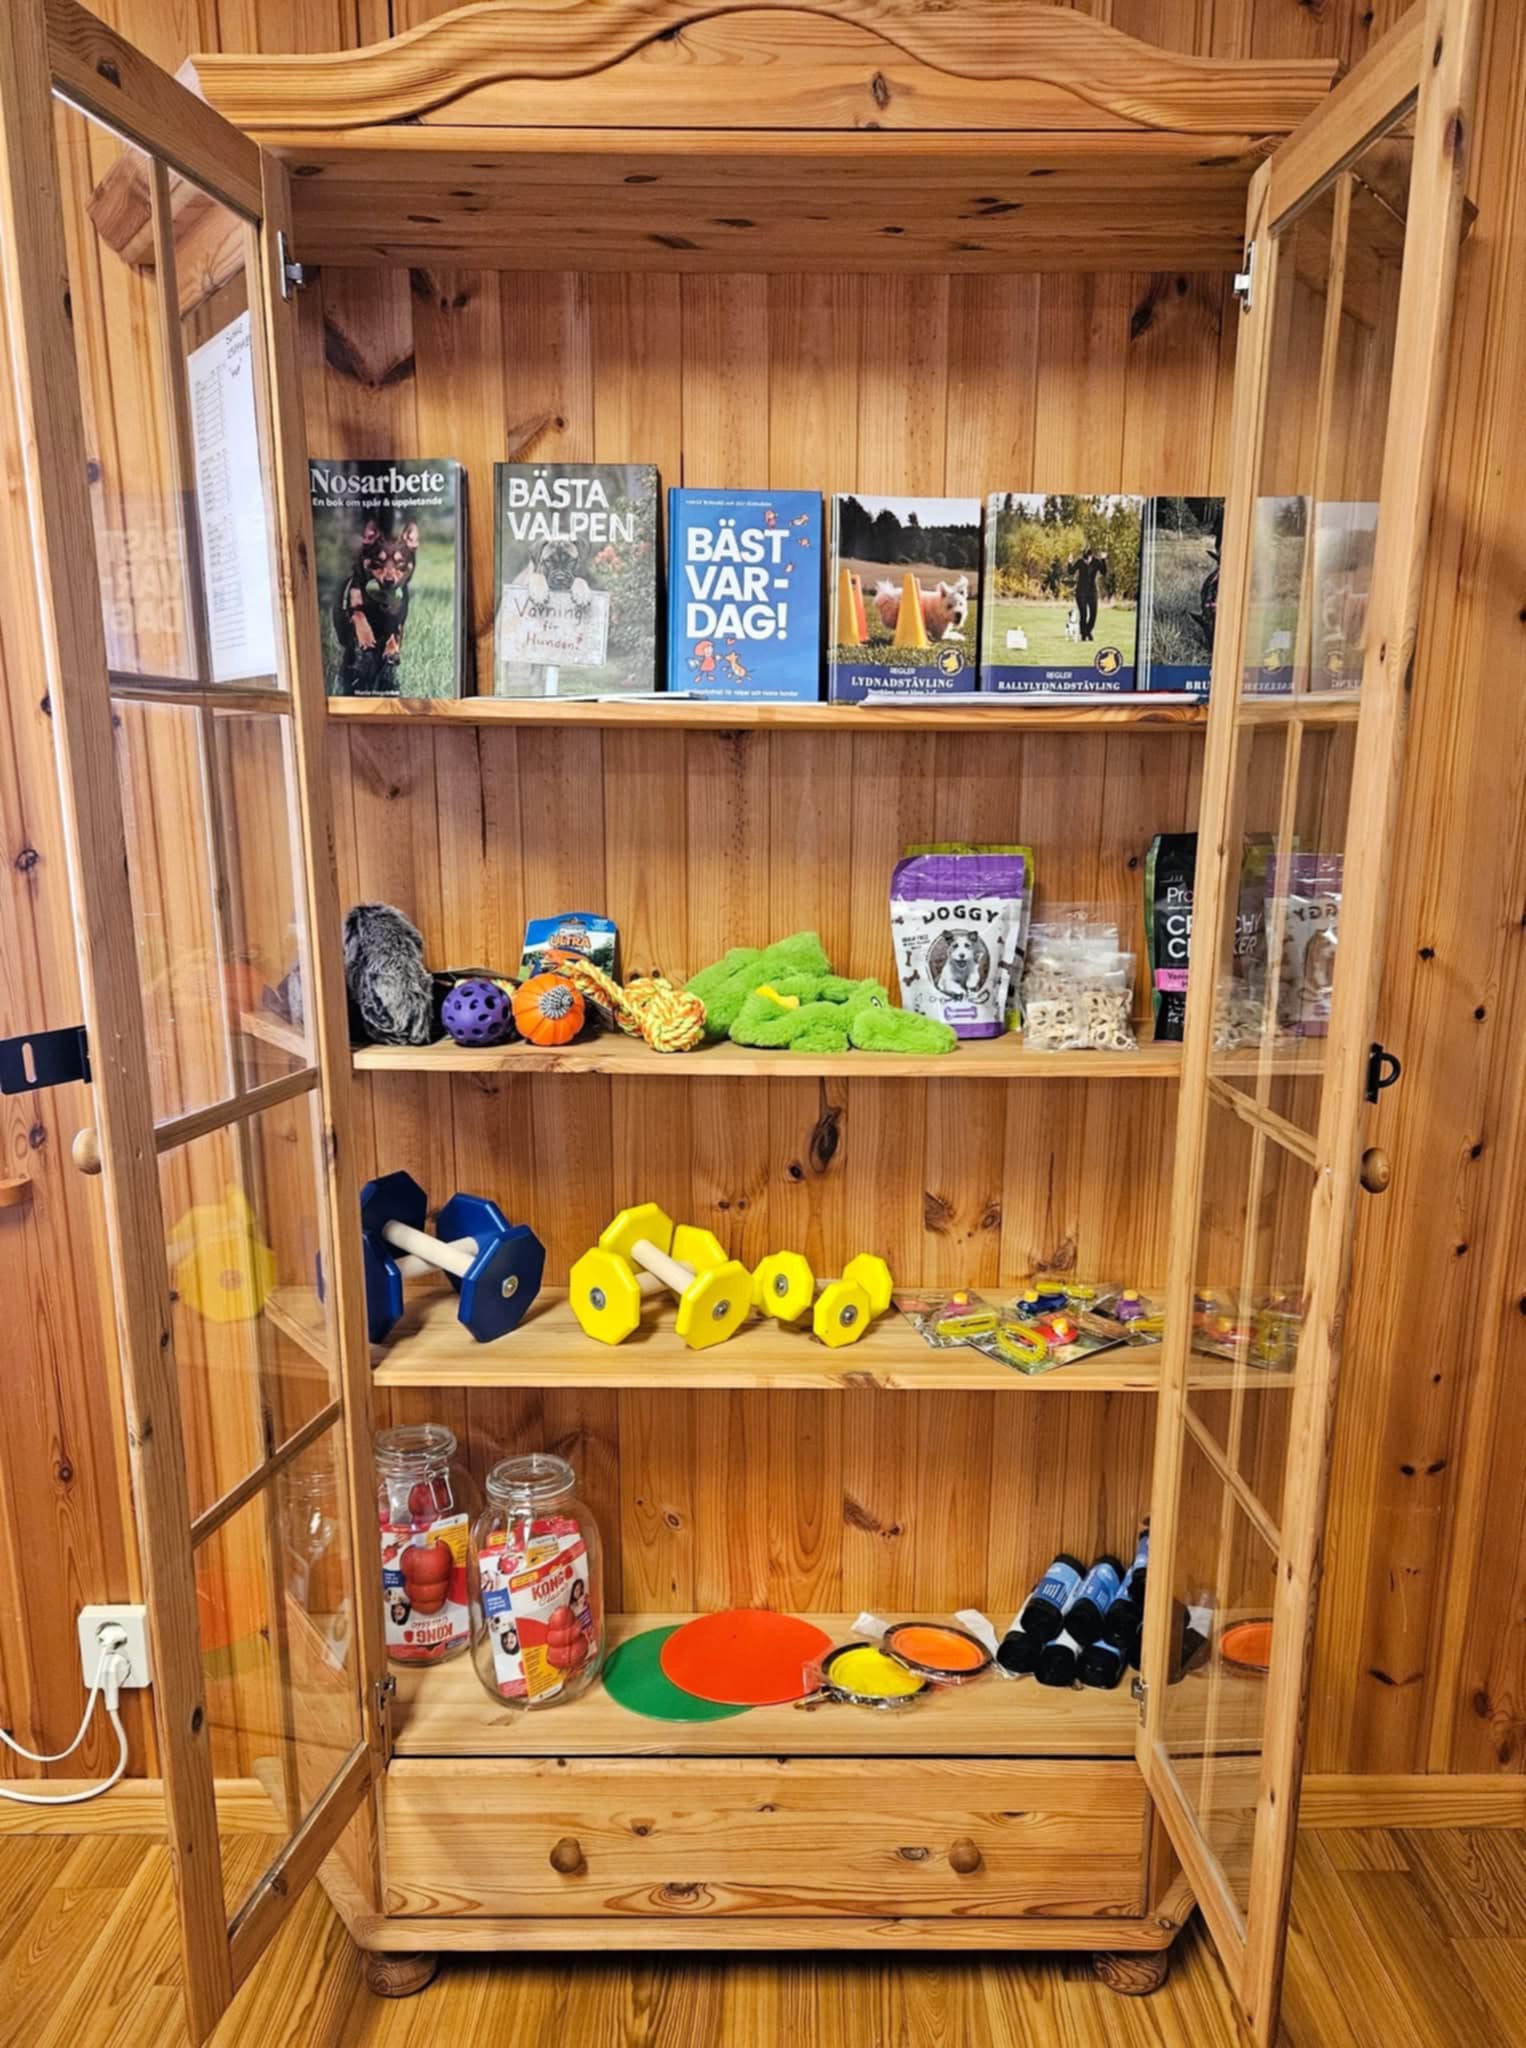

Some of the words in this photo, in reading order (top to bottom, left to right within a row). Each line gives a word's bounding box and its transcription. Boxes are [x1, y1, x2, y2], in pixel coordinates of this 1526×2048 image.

[310, 467, 446, 494] Nosarbete
[508, 469, 609, 509] BÄSTA
[312, 498, 325, 507] En
[326, 498, 345, 507] bok
[507, 511, 635, 542] VALPEN
[687, 518, 790, 564] BÄST
[684, 565, 789, 601] VAR-
[686, 602, 788, 640] DAG!
[851, 676, 954, 688] LYDNADSTÄVLING
[998, 680, 1121, 690] RALLYLYDNADSTÄVLING
[922, 904, 999, 925] DOGGY
[550, 935, 592, 949] ULTRA
[532, 1570, 565, 1601] KONG
[416, 1622, 453, 1644] KONG
